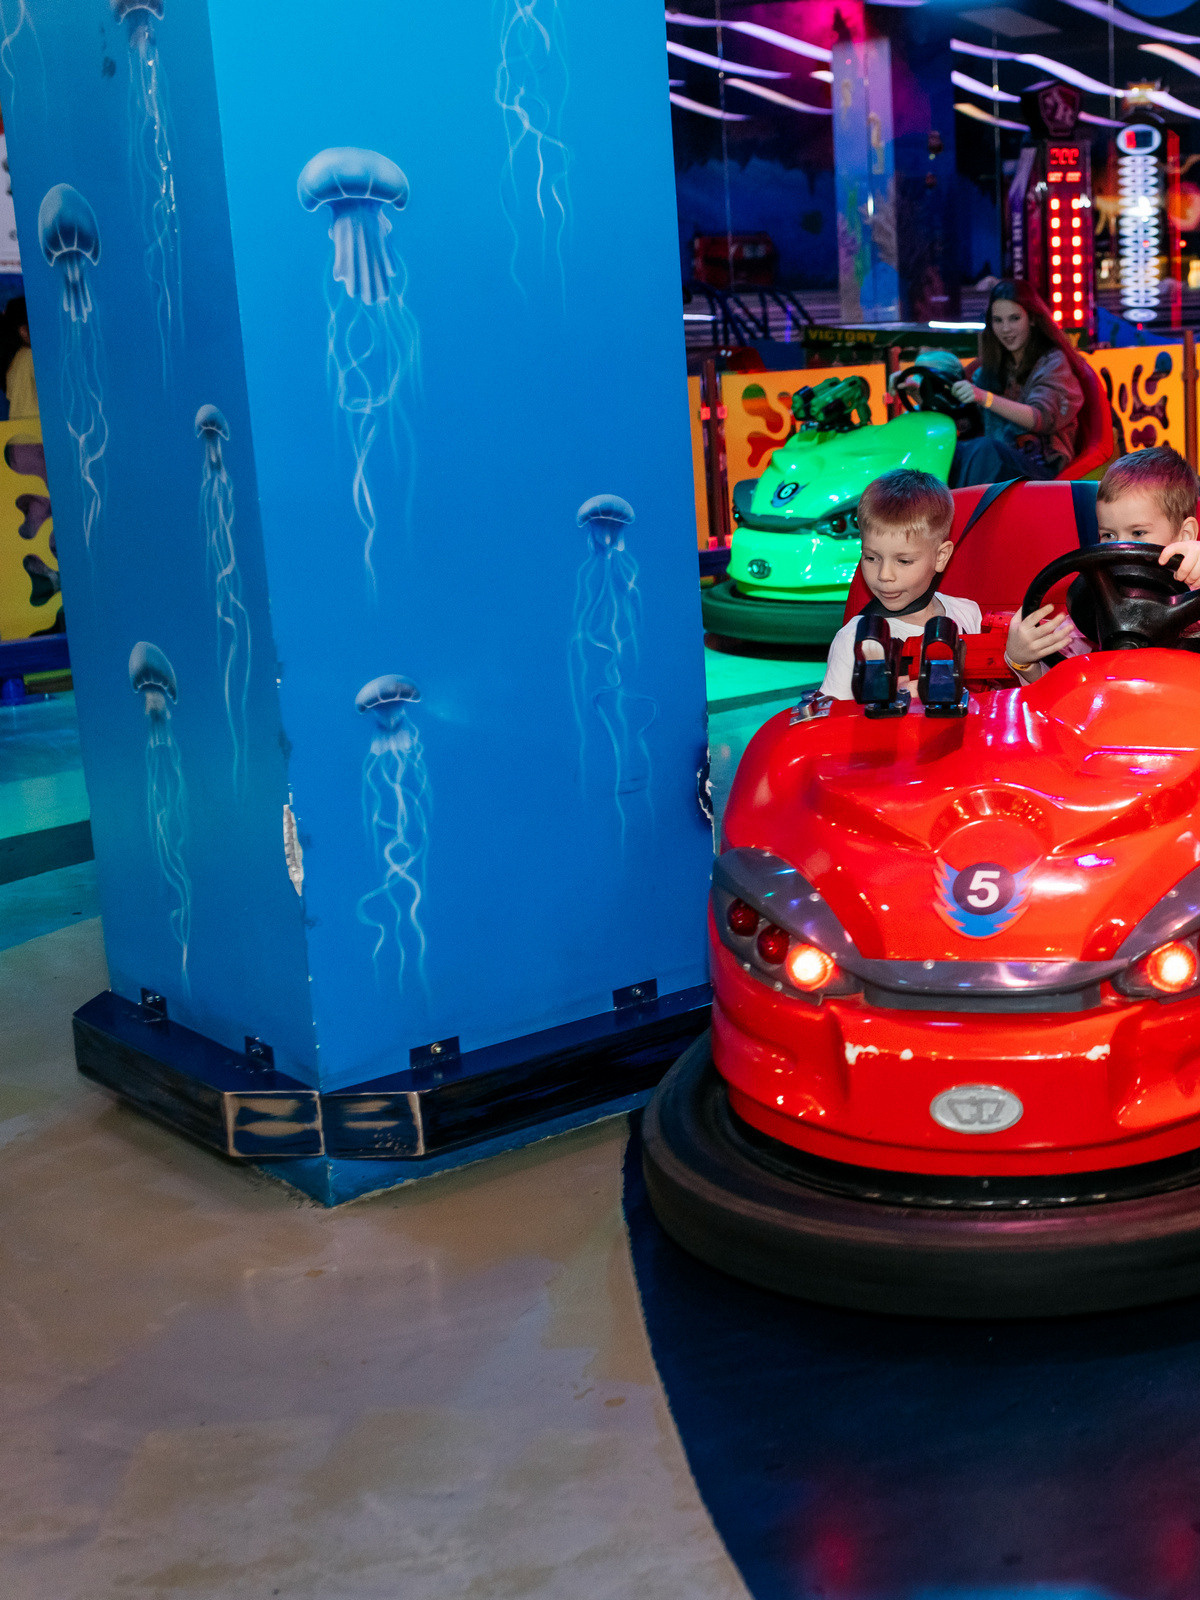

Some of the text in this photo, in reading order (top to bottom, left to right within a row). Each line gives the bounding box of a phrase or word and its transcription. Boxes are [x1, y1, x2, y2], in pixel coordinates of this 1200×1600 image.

[808, 329, 877, 343] VICTORY
[780, 483, 796, 498] 6
[967, 870, 1000, 908] 5
